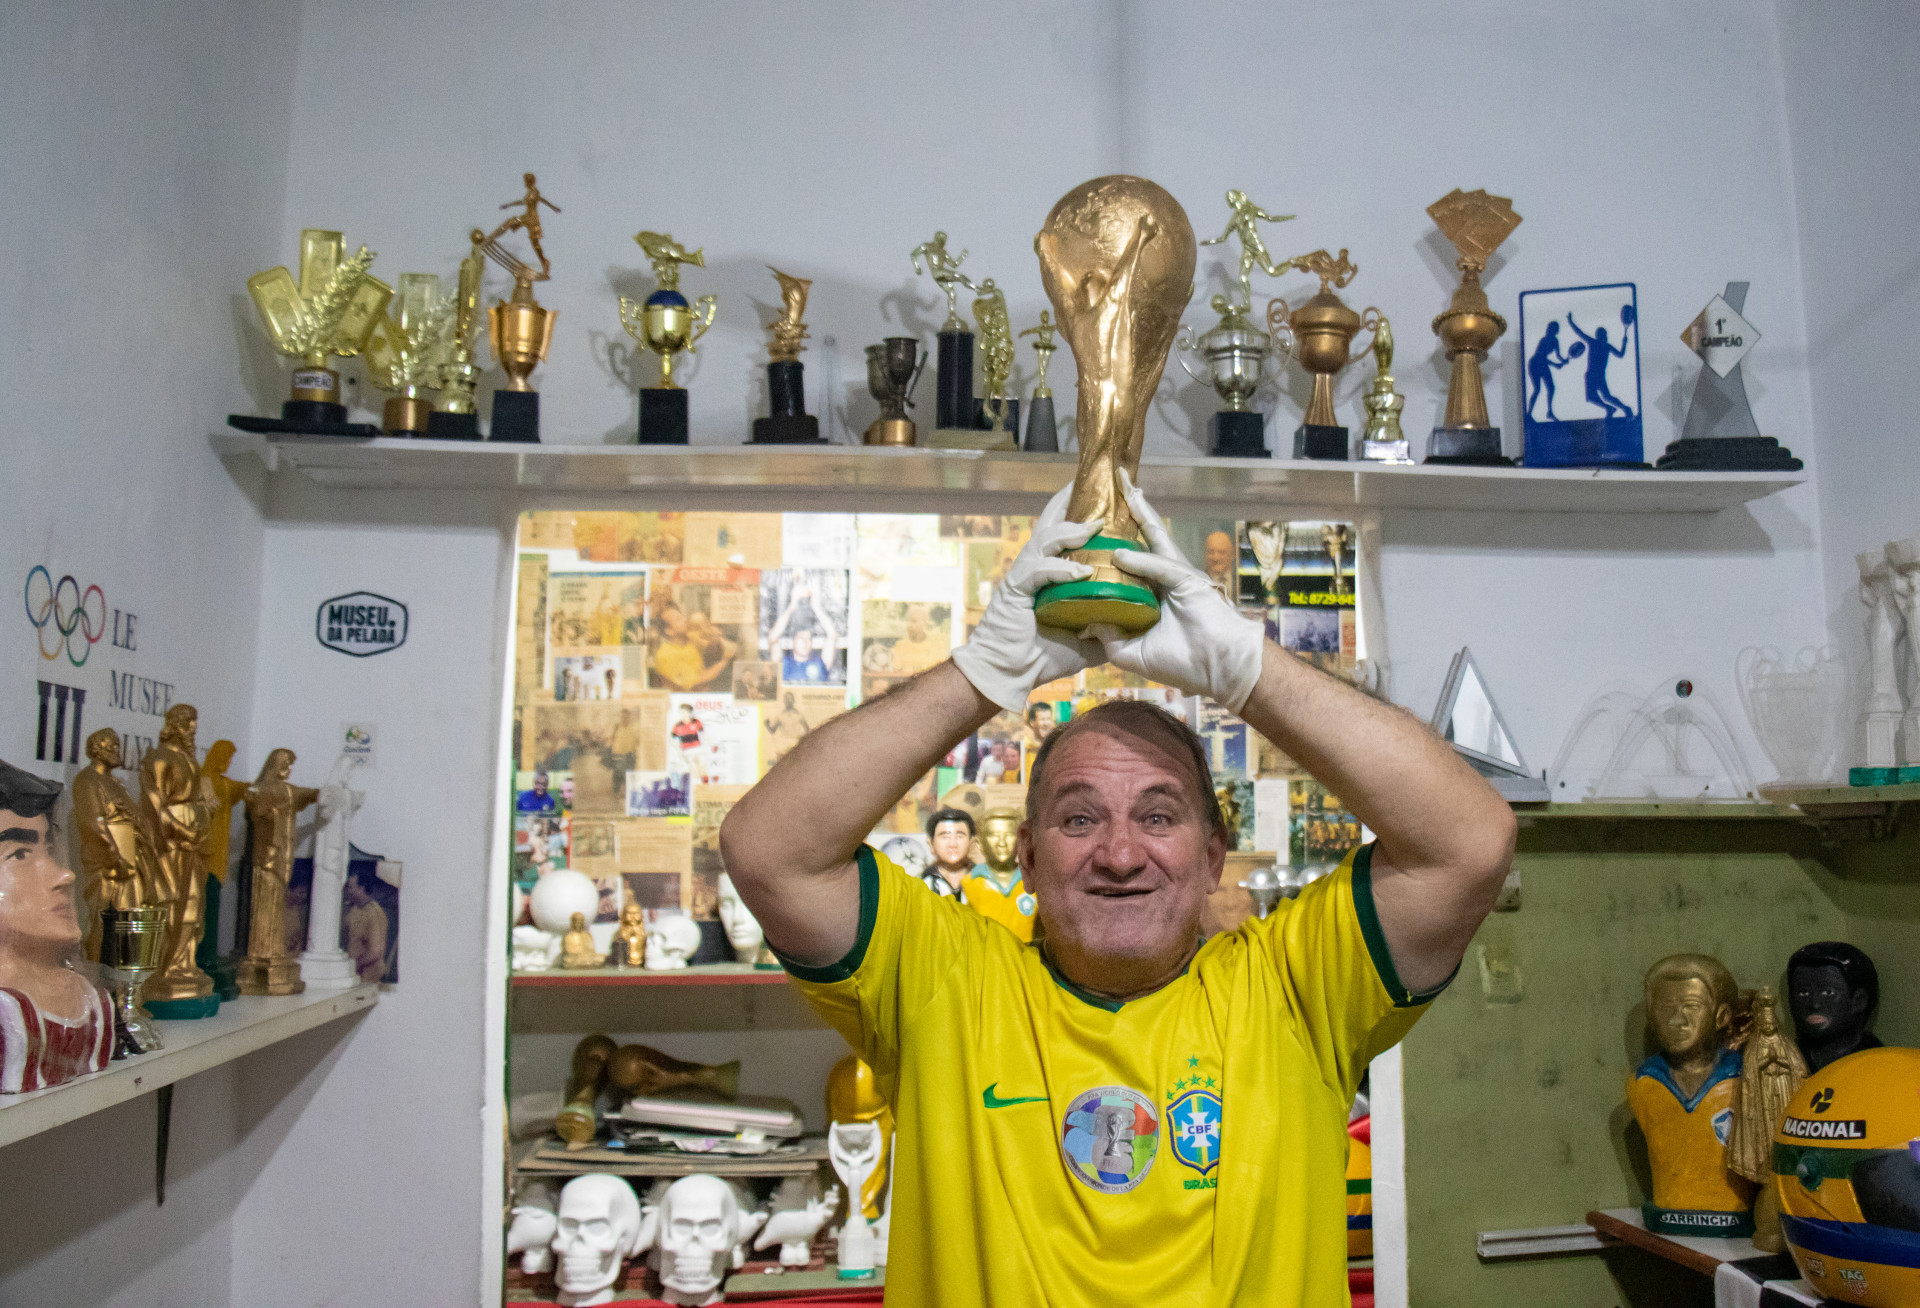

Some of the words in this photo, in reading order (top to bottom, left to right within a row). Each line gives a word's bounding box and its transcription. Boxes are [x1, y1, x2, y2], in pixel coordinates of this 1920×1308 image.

[113, 609, 138, 652] LE
[327, 627, 343, 642] DA
[346, 627, 396, 644] PELADA
[1187, 1124, 1212, 1135] CBF
[1782, 1118, 1862, 1138] NACIONAL
[1660, 1214, 1740, 1227] GARRINCHA
[1839, 1268, 1864, 1281] TAG
